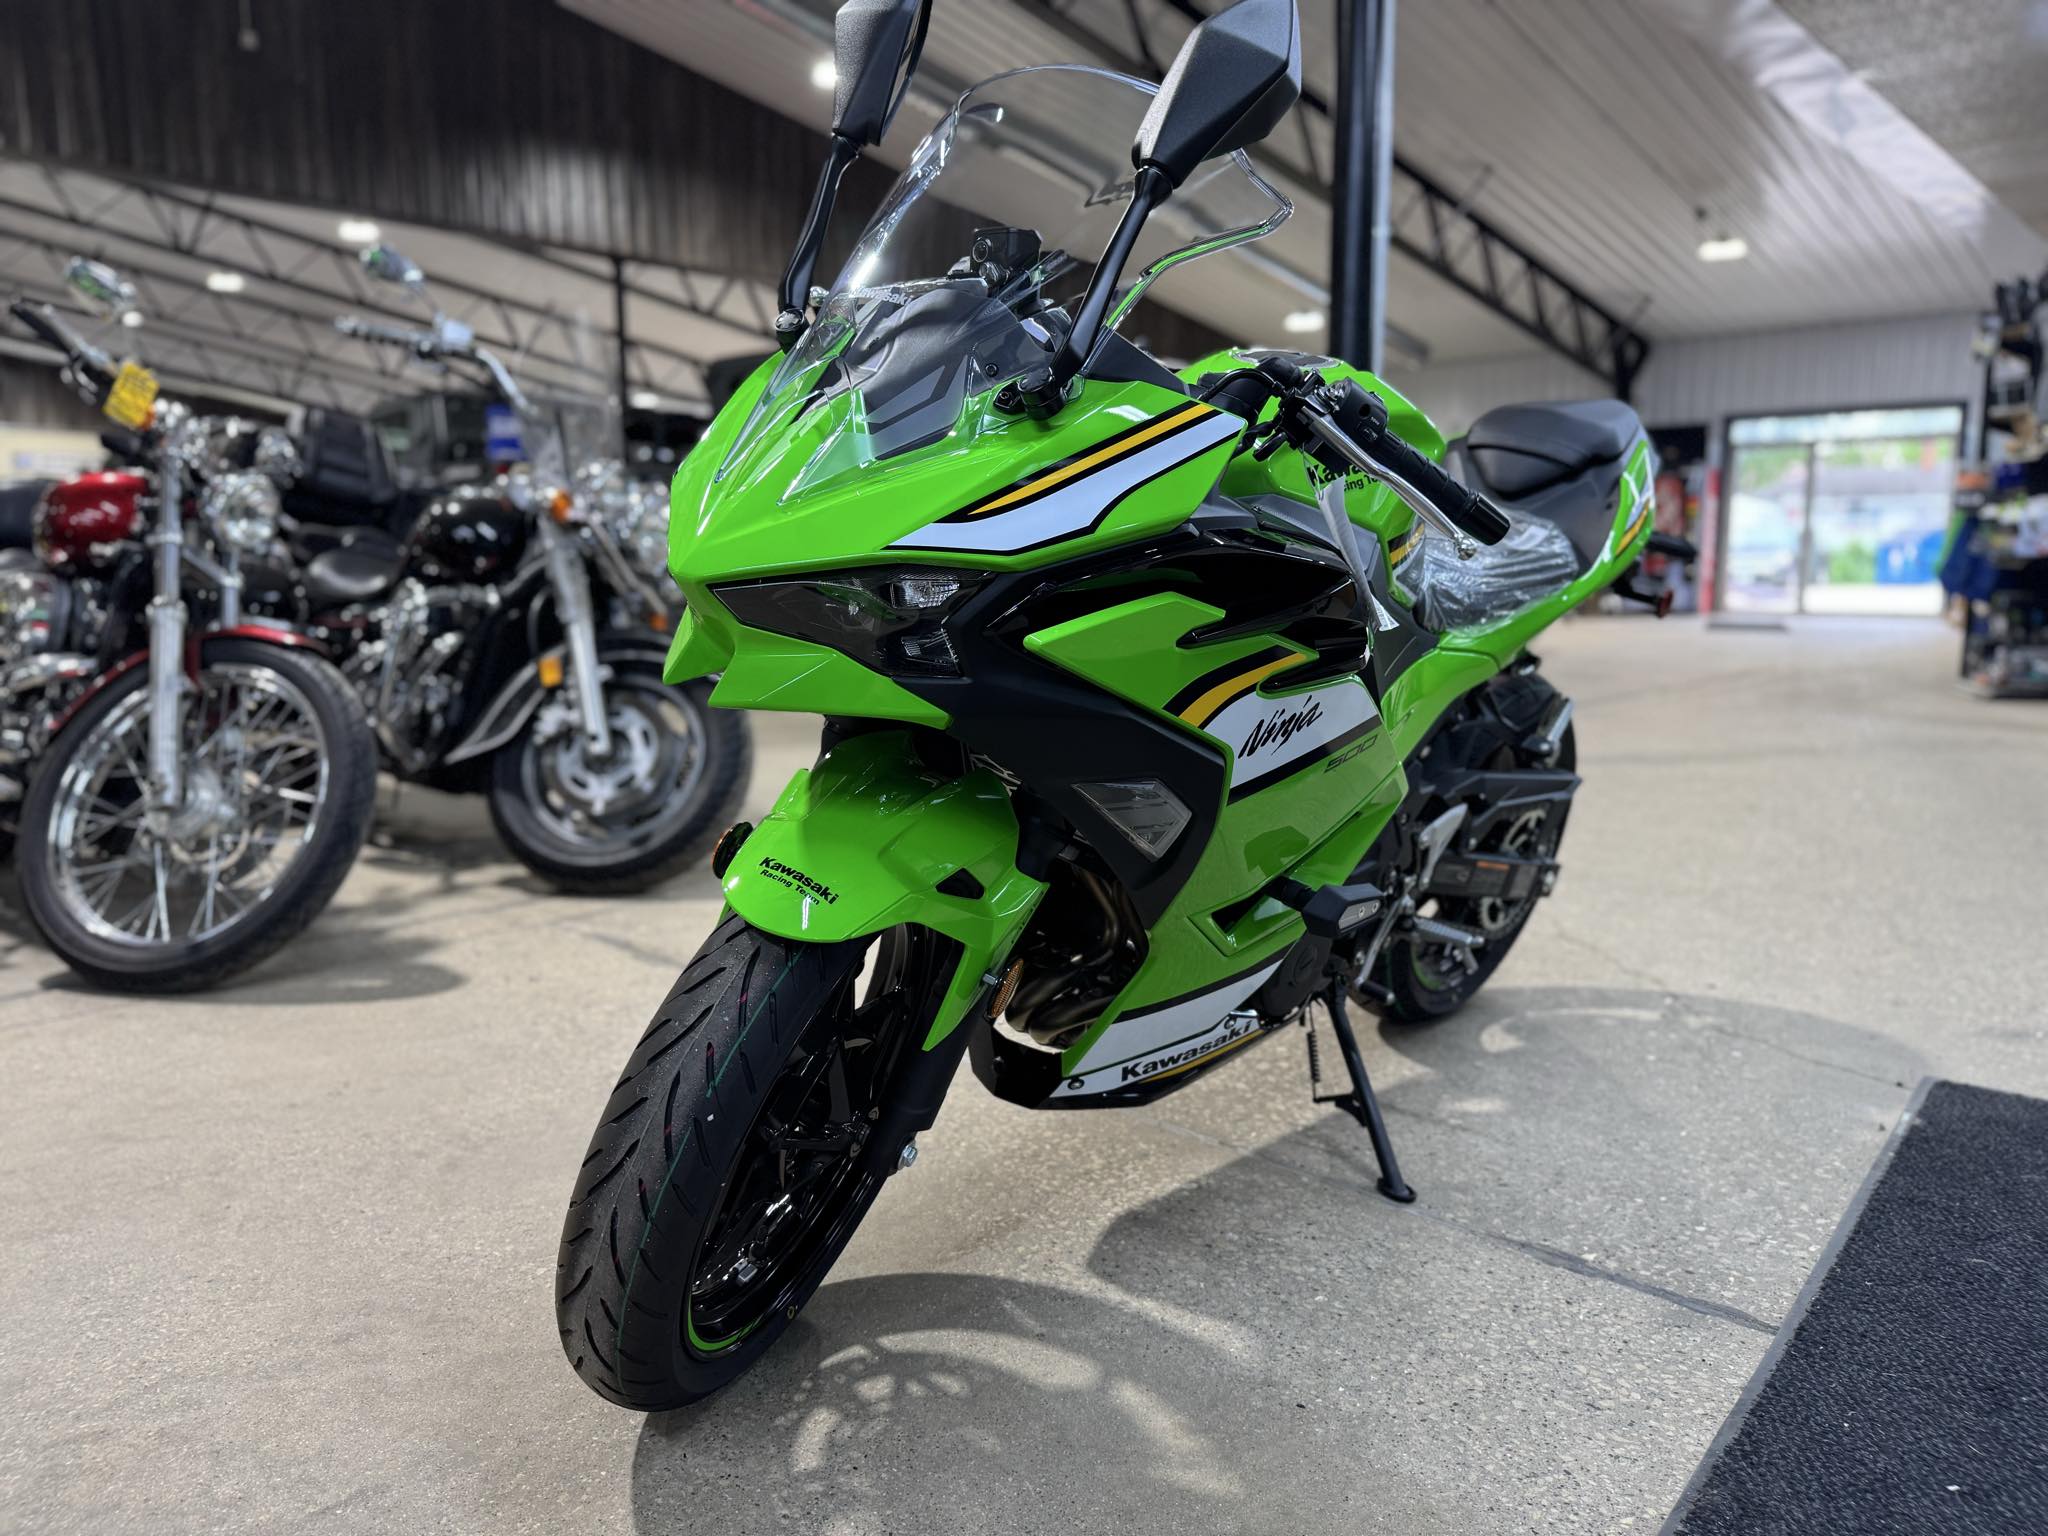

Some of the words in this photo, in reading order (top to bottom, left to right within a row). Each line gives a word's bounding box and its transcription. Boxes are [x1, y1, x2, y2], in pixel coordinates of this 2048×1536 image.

[1238, 695, 1323, 759] Ninja
[1324, 734, 1378, 773] 500
[759, 857, 839, 905] Kawasaki
[760, 869, 793, 888] Racing
[795, 884, 820, 905] Team
[1121, 1020, 1253, 1081] Kawasaki
